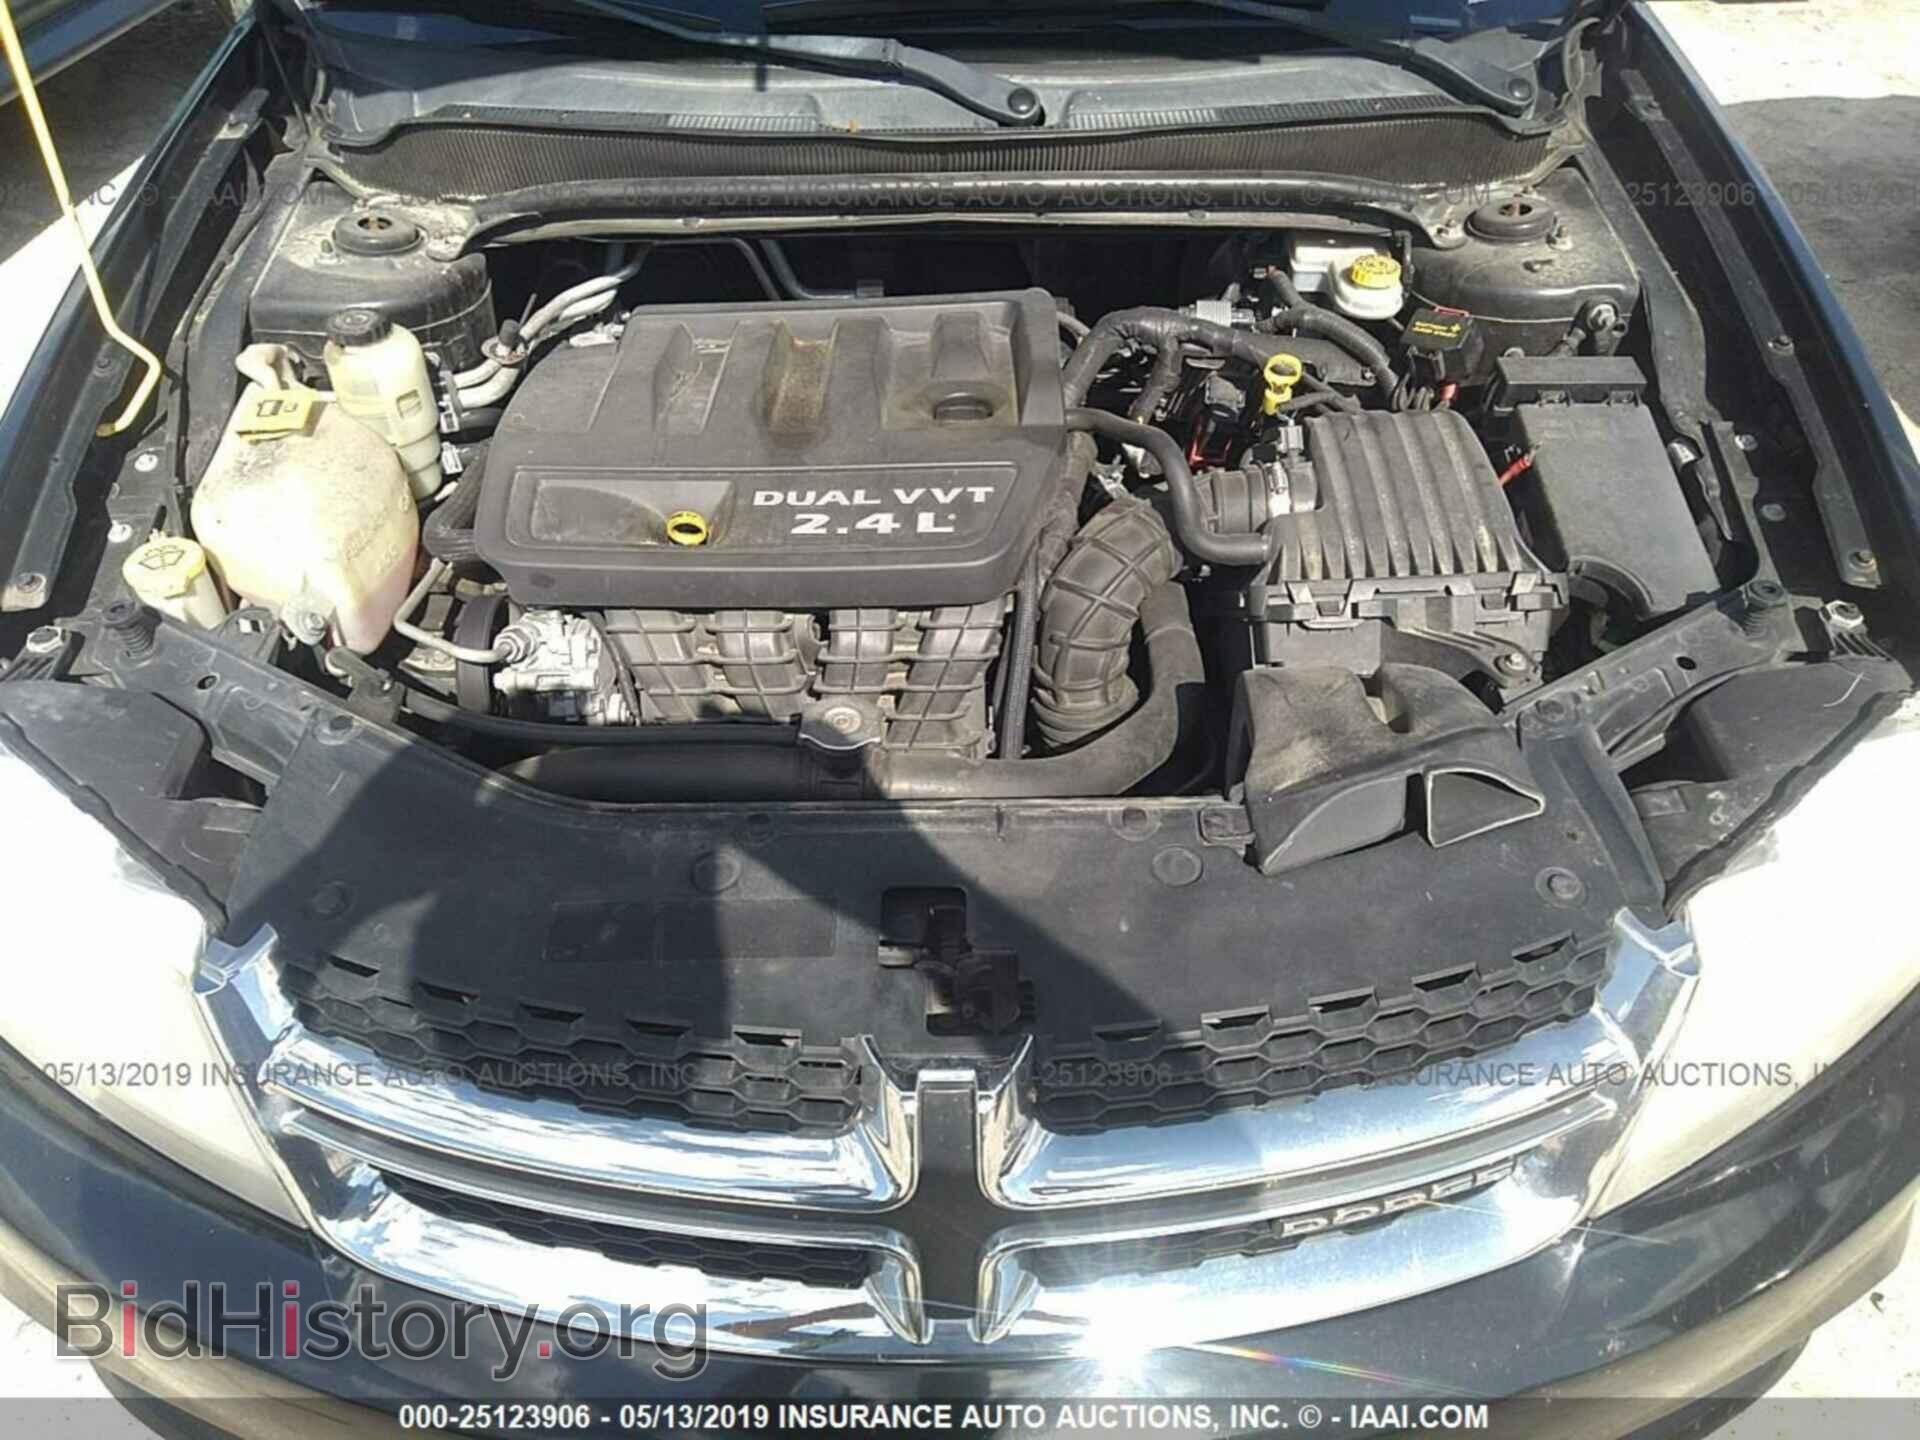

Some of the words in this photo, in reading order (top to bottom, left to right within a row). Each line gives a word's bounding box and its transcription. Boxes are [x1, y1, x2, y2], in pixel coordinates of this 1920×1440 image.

[752, 489, 881, 506] DUAL
[893, 487, 995, 505] VVT
[790, 512, 900, 534] 2.4
